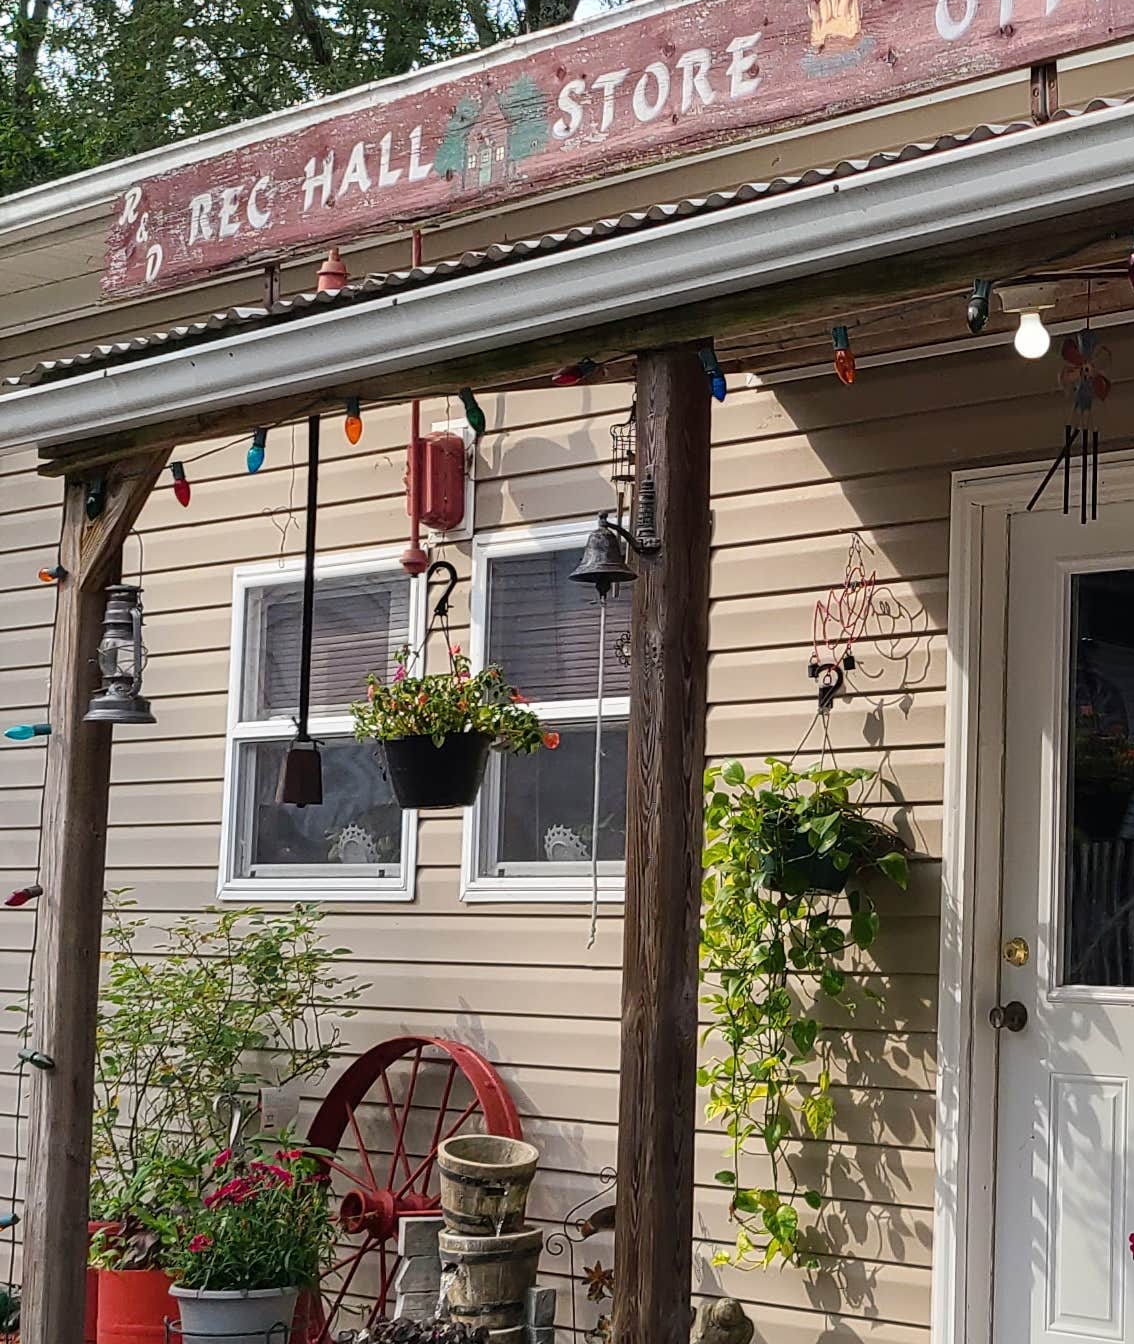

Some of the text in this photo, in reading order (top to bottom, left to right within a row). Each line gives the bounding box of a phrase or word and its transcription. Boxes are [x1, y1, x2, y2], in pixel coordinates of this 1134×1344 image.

[188, 175, 272, 246] REC
[302, 126, 434, 212] HALL
[552, 32, 763, 141] STORE
[118, 186, 164, 283] R & D
